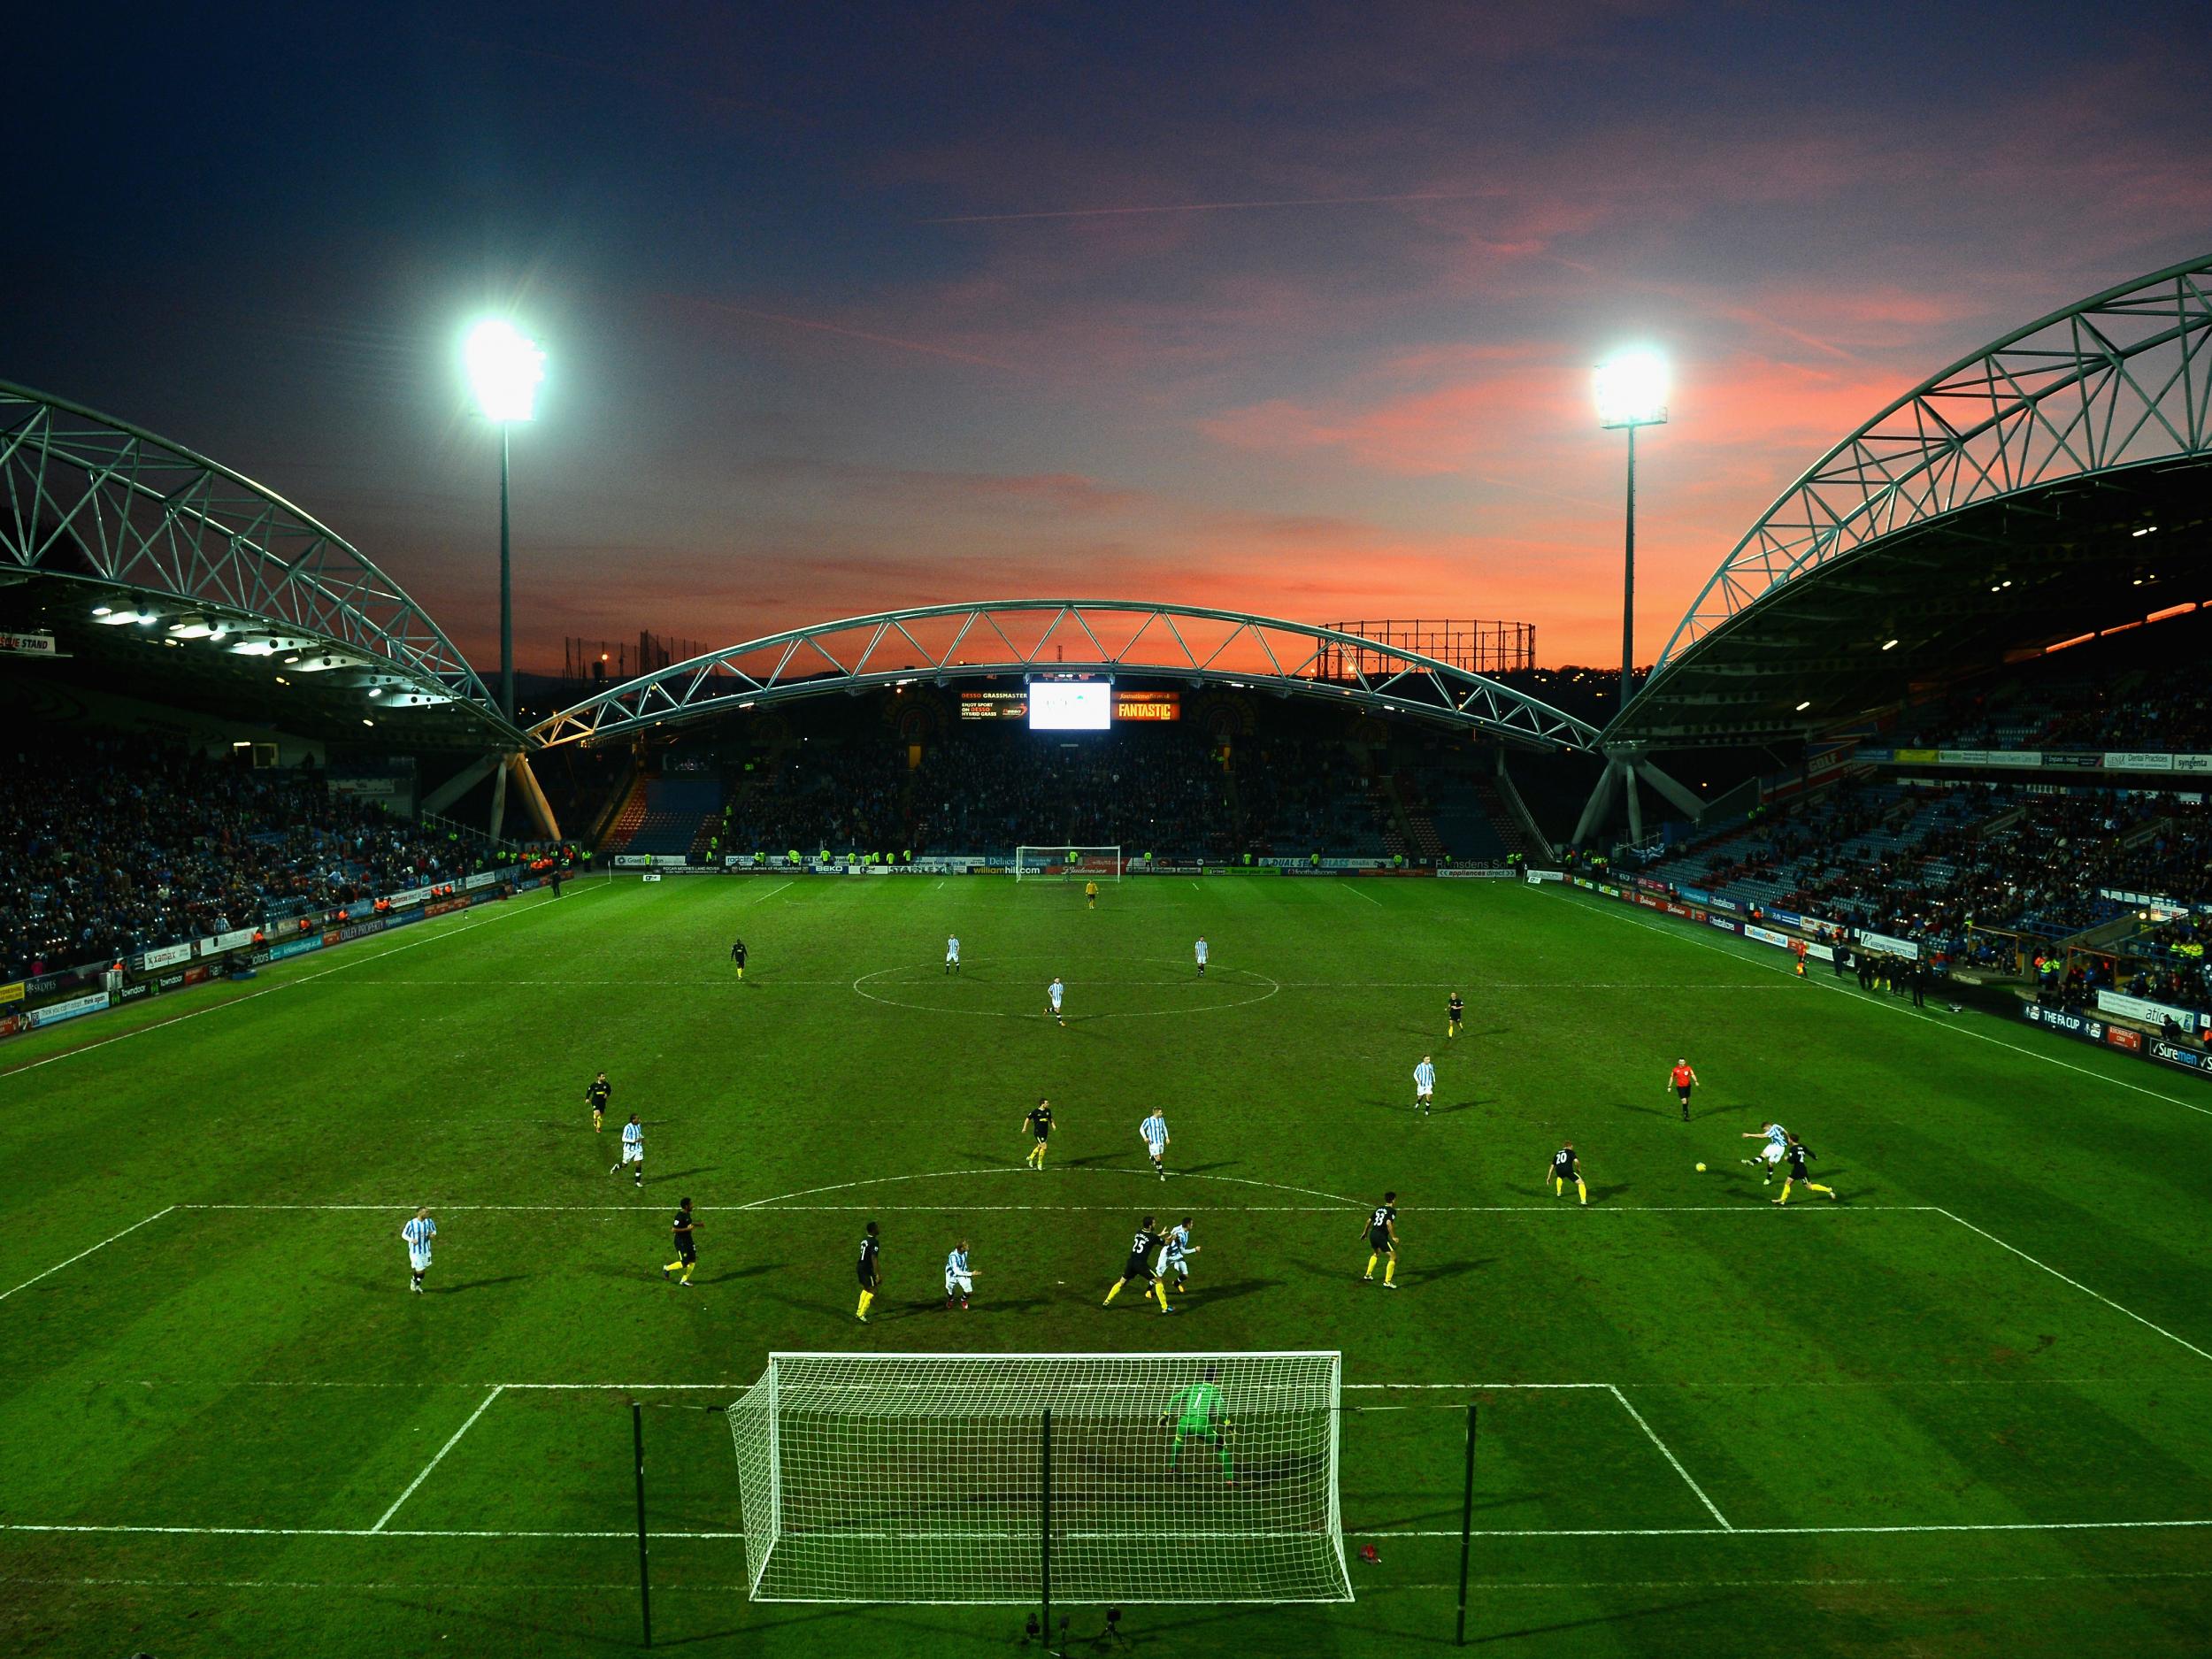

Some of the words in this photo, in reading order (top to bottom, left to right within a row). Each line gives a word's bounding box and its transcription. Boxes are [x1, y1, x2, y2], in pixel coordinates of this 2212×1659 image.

[22, 639, 48, 649] STAND
[1118, 703, 1171, 718] FANTASTIC
[1809, 752, 1839, 772] GOLF
[2178, 757, 2208, 770] syngenta
[357, 920, 383, 936] PROPERTY
[160, 975, 183, 987] Towndoor
[121, 985, 146, 997] Towndoor
[2043, 1010, 2057, 1025] THE
[2057, 1014, 2066, 1027] FA
[2066, 1018, 2080, 1031] CUP
[1555, 1152, 1567, 1165] 20
[1373, 1212, 1386, 1226] 33
[1132, 1239, 1147, 1254] 25
